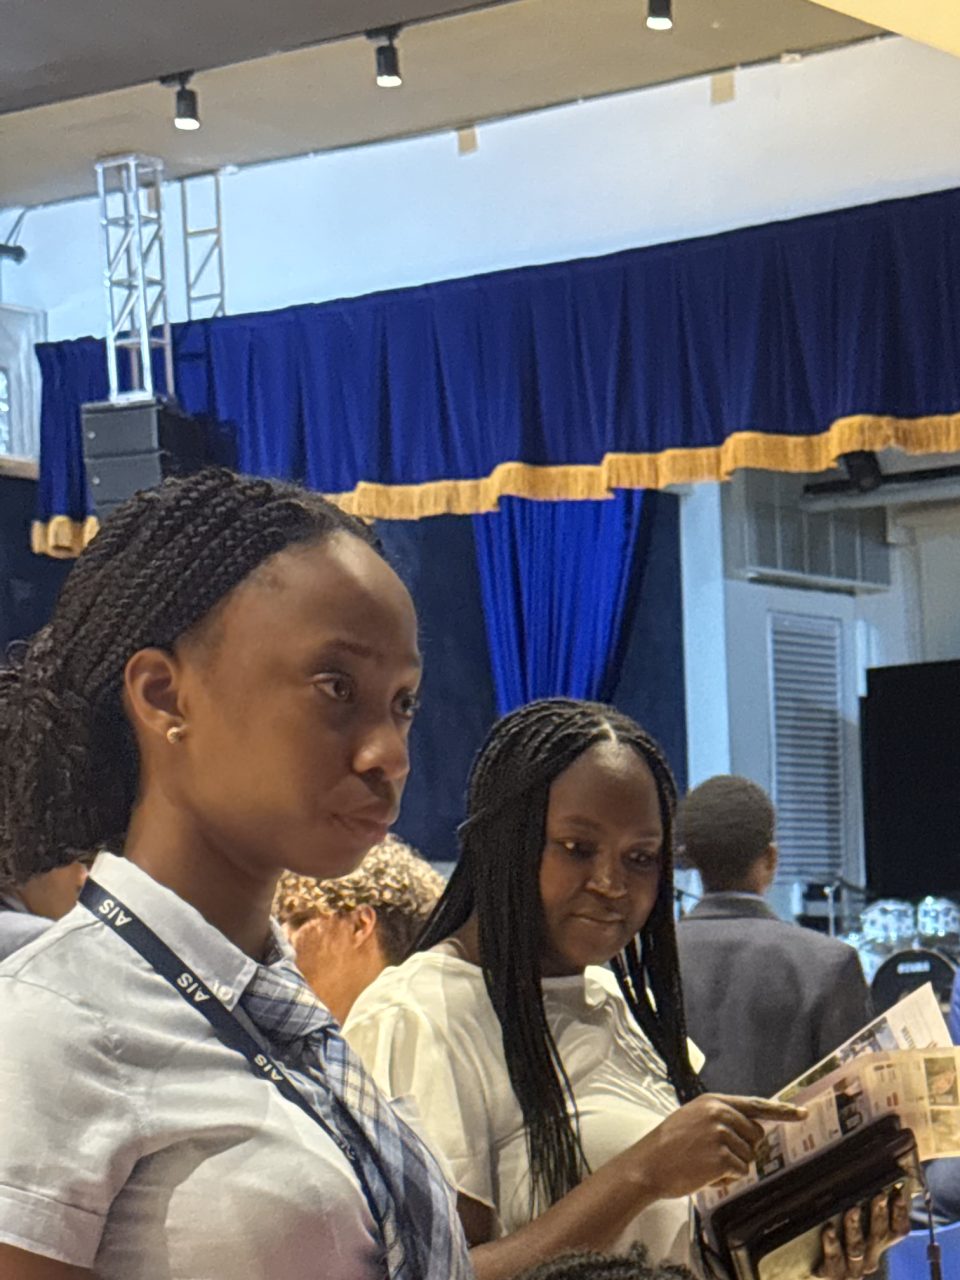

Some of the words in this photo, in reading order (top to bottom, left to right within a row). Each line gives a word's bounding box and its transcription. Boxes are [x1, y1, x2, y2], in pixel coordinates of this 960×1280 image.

[98, 898, 133, 927] AIS
[176, 972, 211, 1003] AIS
[253, 1053, 284, 1082] AIS
